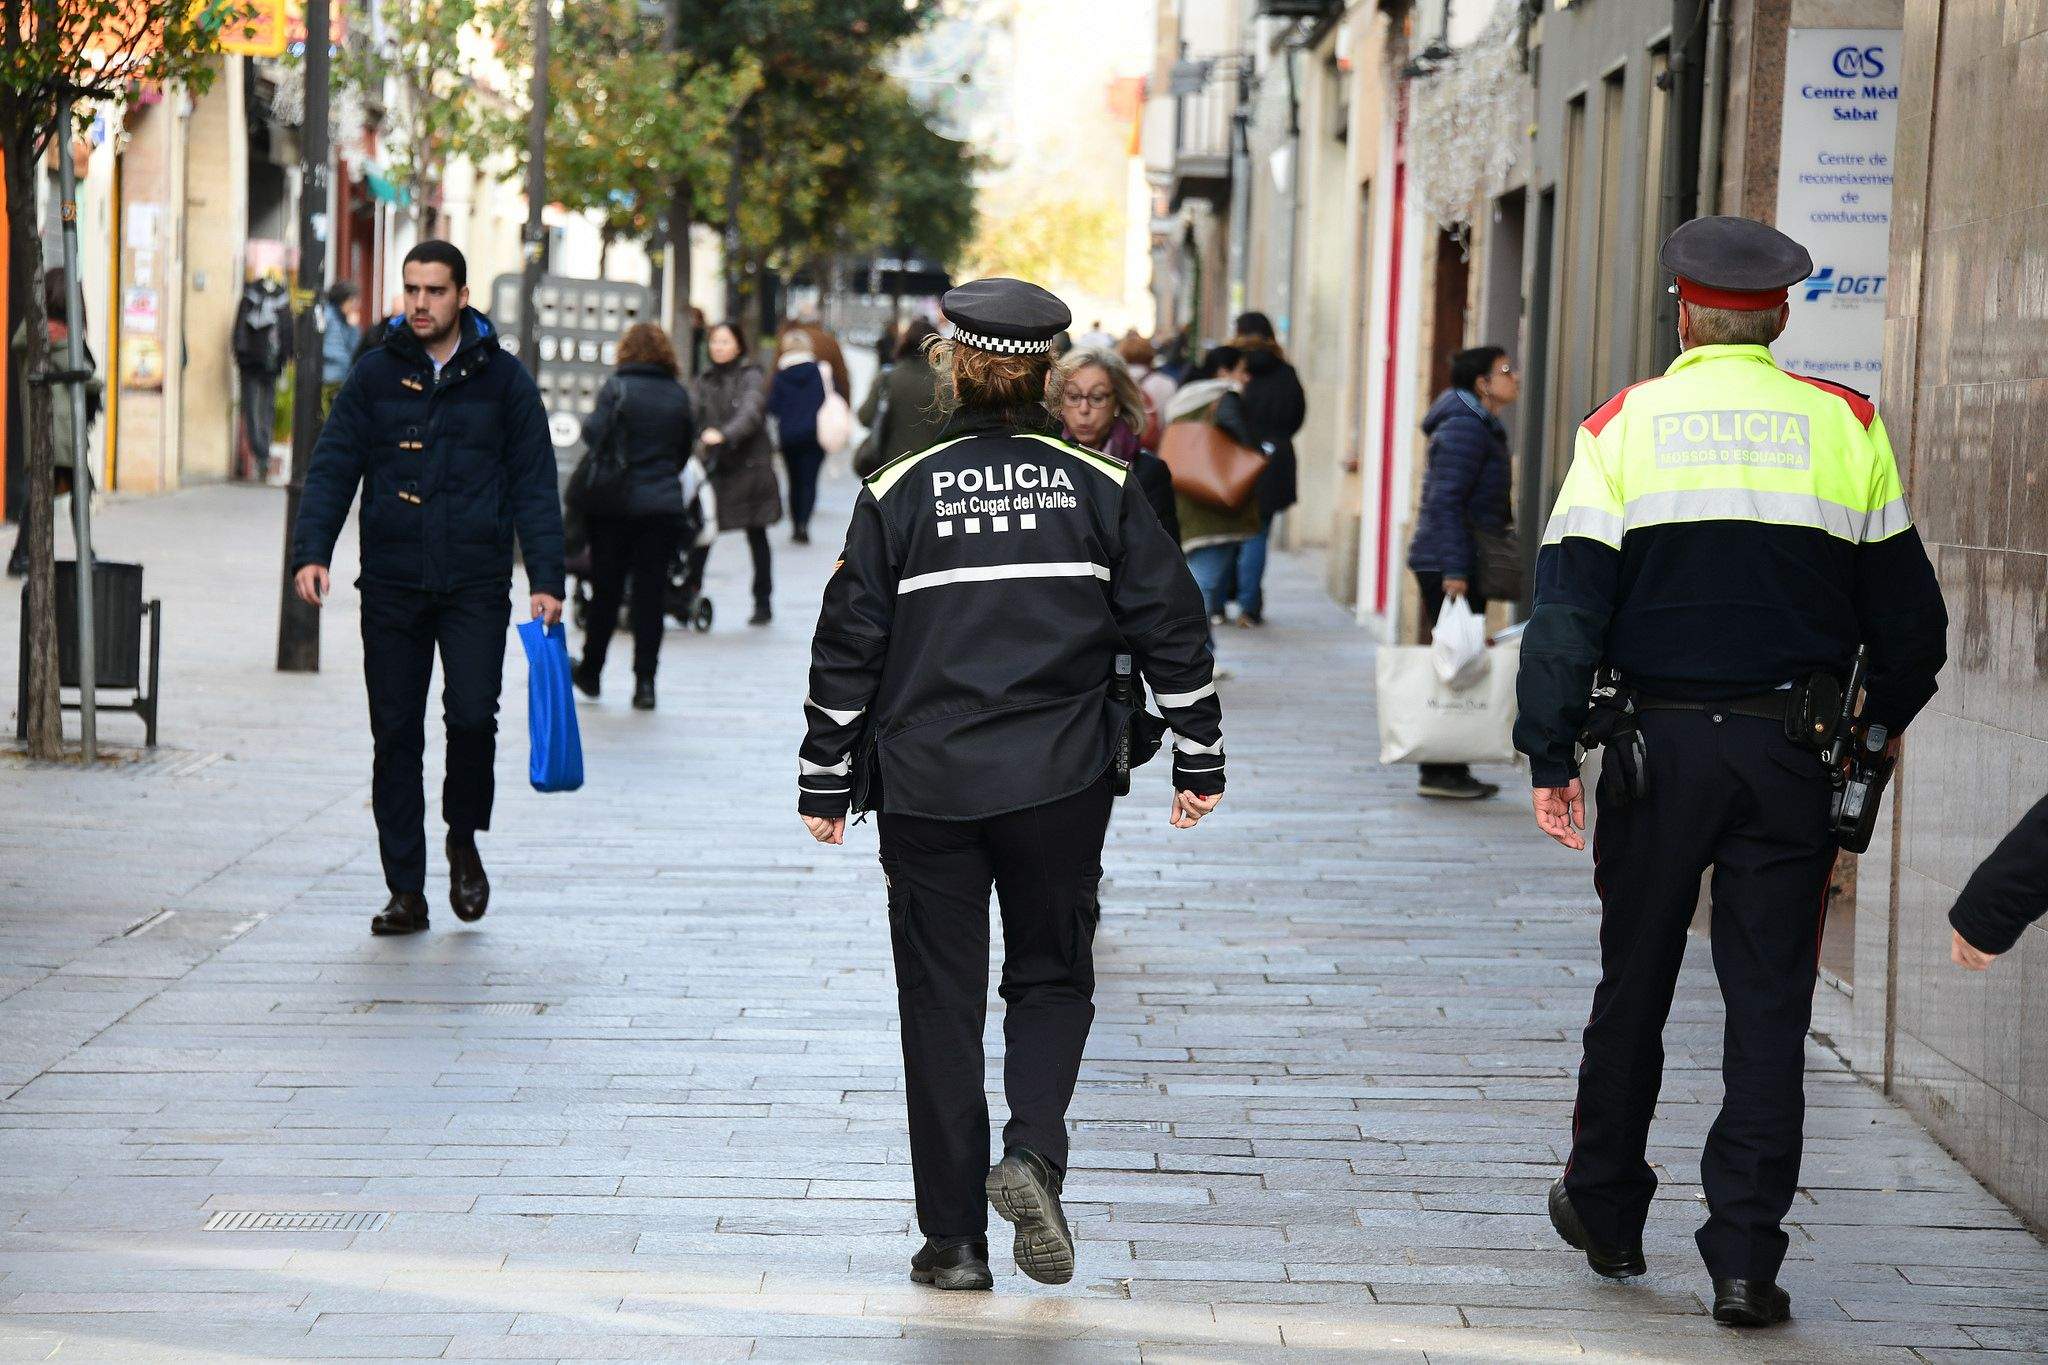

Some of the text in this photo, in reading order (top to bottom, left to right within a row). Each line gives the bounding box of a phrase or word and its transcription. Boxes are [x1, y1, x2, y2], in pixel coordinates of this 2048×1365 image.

[1802, 86, 1856, 99] Centre
[1833, 107, 1878, 121] Sabat
[1818, 152, 1888, 166] Centre de
[1841, 192, 1859, 204] de
[1809, 212, 1888, 223] conductors
[1837, 276, 1886, 295] DGT
[1658, 412, 1805, 446] POLICIA
[1661, 449, 1716, 465] MOSSOS
[932, 463, 1075, 497] POLICIA
[935, 491, 1077, 517] Sant Cugat del Vallès
